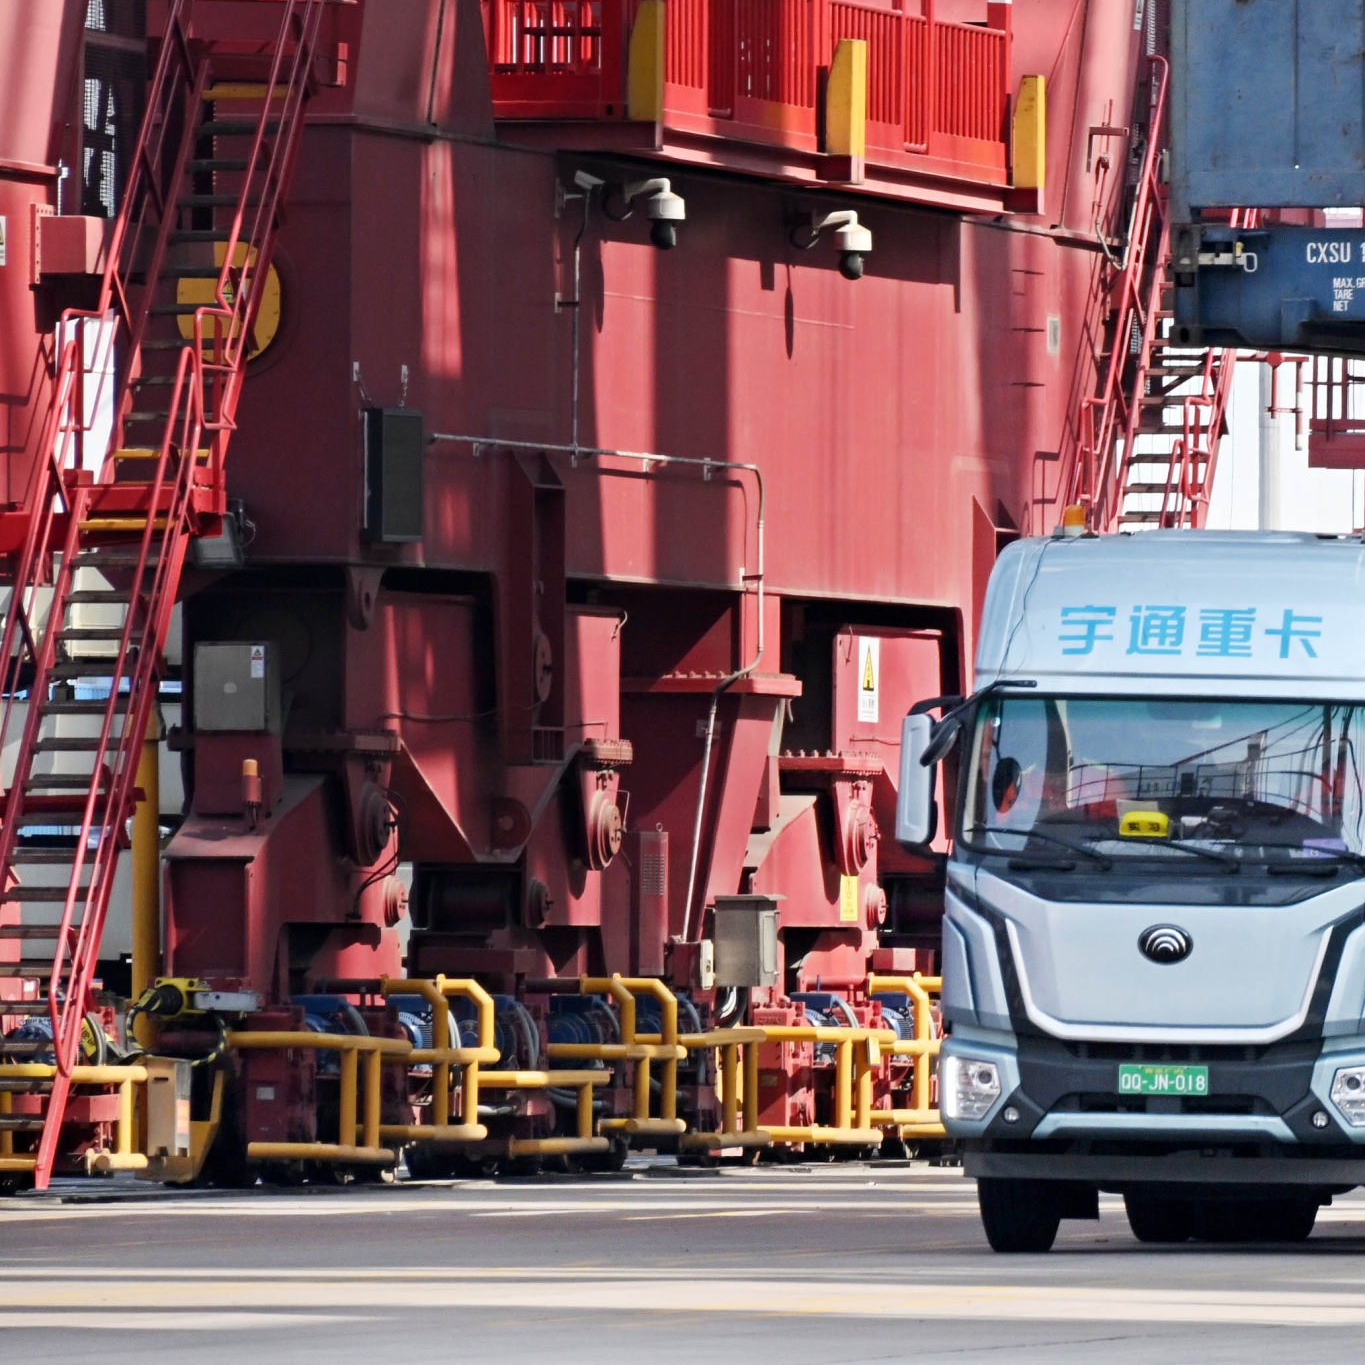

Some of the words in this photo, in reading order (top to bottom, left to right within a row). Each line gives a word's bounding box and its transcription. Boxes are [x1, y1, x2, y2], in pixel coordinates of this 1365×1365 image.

[1306, 242, 1351, 263] CXSU
[1333, 289, 1353, 299] TARE
[1333, 300, 1348, 311] NET
[1058, 605, 1323, 659] 宇通重卡
